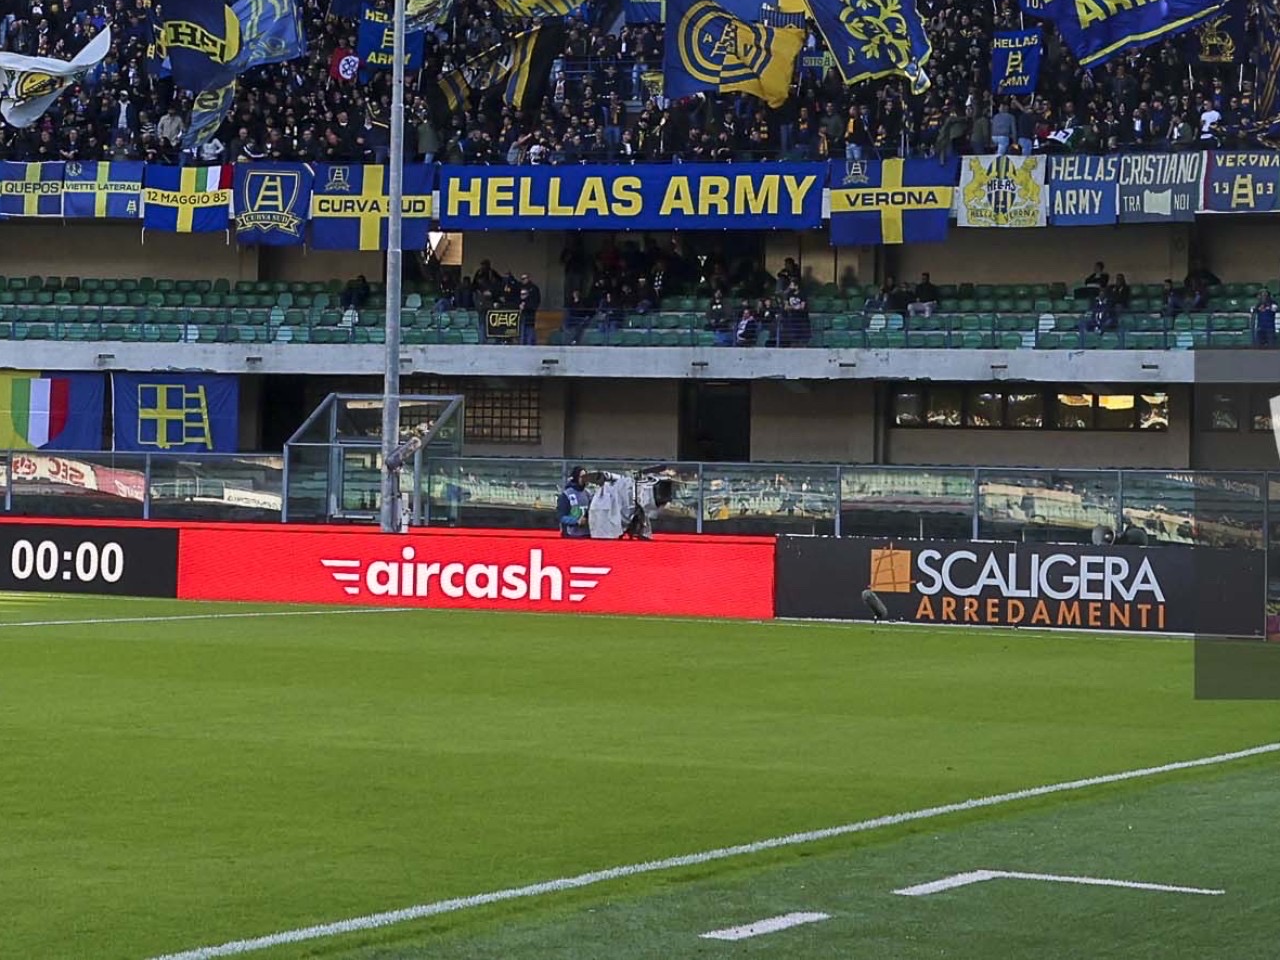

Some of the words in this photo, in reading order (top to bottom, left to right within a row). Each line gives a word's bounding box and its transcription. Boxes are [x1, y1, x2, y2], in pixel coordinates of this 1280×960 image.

[993, 35, 1038, 49] HELLAS
[1051, 156, 1118, 181] HELLAS
[1120, 153, 1201, 186] CRISTIANO
[1214, 153, 1280, 168] VERONA
[4, 181, 59, 195] QUEPOS
[447, 175, 643, 216] HELLAS
[659, 174, 818, 216] ARMY
[986, 179, 1018, 192] HELLAS
[147, 192, 158, 202] 12
[160, 192, 210, 205] MAGGIO
[212, 192, 228, 204] 85
[318, 199, 381, 214] CURVA
[845, 190, 939, 208] VERONA
[1053, 189, 1103, 216] ARMY
[1122, 196, 1141, 212] TRA
[1173, 195, 1190, 210] NOI
[11, 540, 125, 584] 00:00
[365, 545, 562, 600] aircash
[916, 549, 1166, 603] SCALIGERA
[916, 597, 1167, 630] ARREDAMENTI
